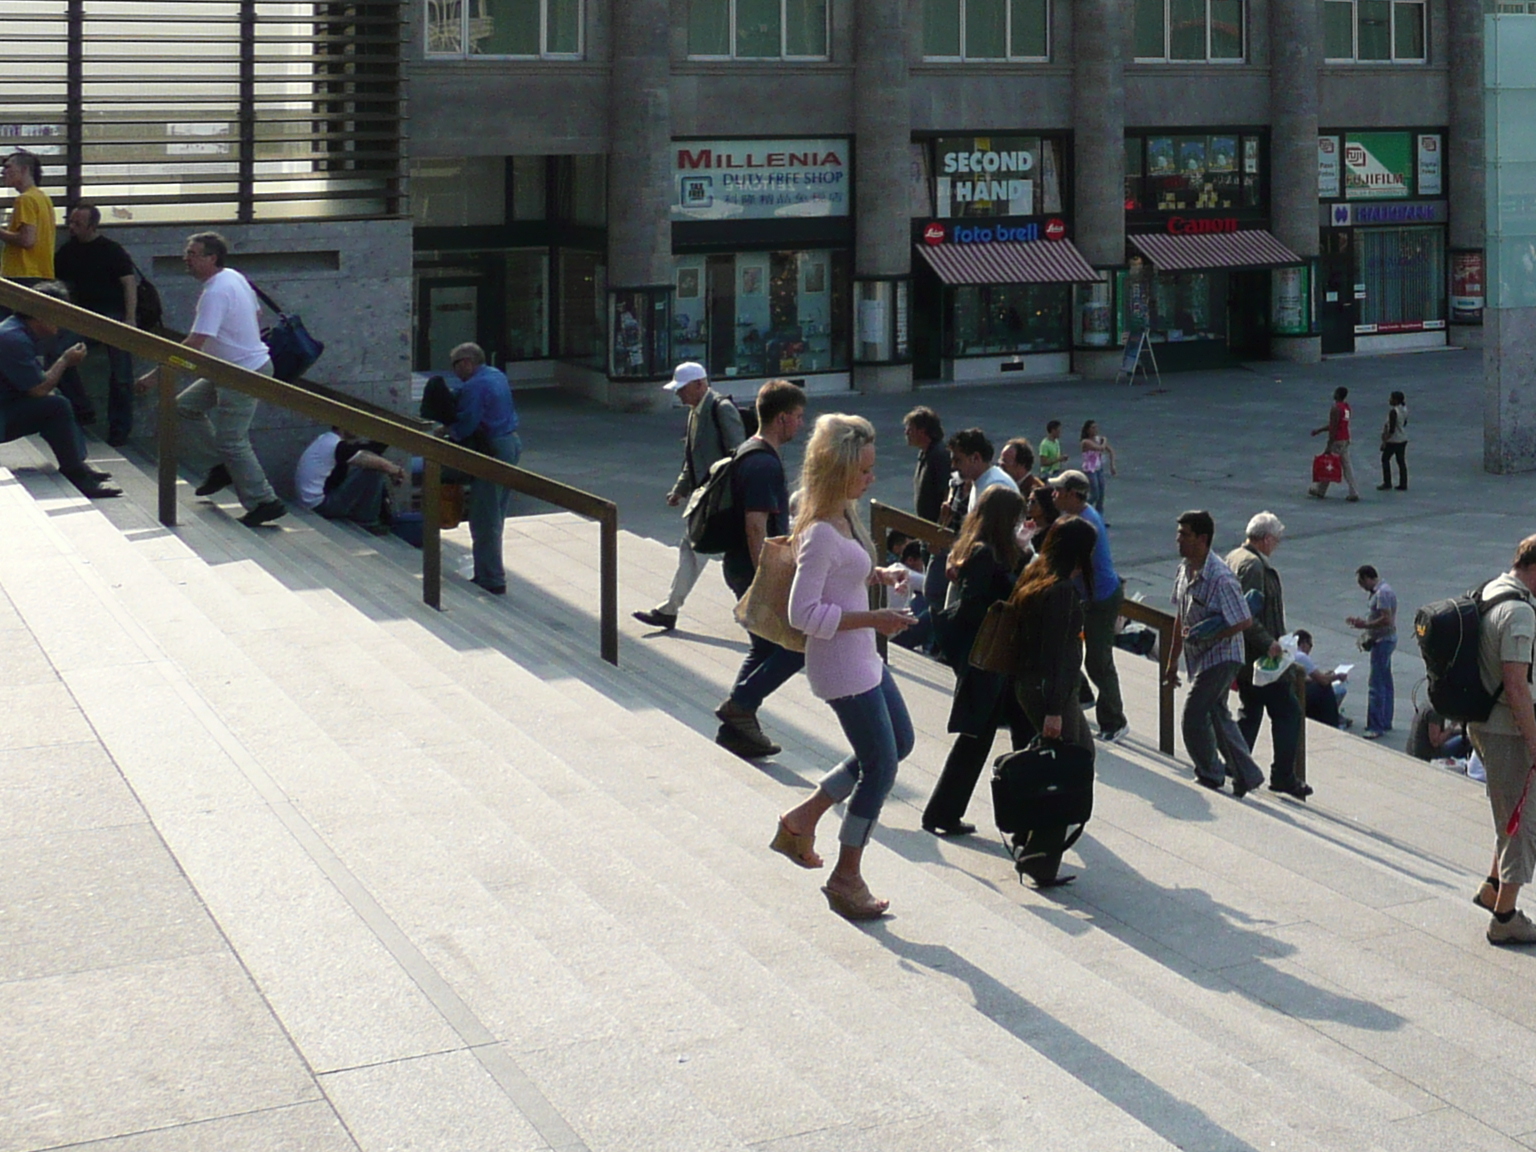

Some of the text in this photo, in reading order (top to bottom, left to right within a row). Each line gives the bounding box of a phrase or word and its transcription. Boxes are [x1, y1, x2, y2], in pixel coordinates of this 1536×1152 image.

[943, 150, 1034, 173] SECOND
[723, 170, 844, 186] DUTY FREE SHOP
[1345, 172, 1404, 185] FUJIFILM
[956, 179, 1023, 202] HAND
[953, 222, 1039, 244] foto brell
[1166, 215, 1240, 235] Canon
